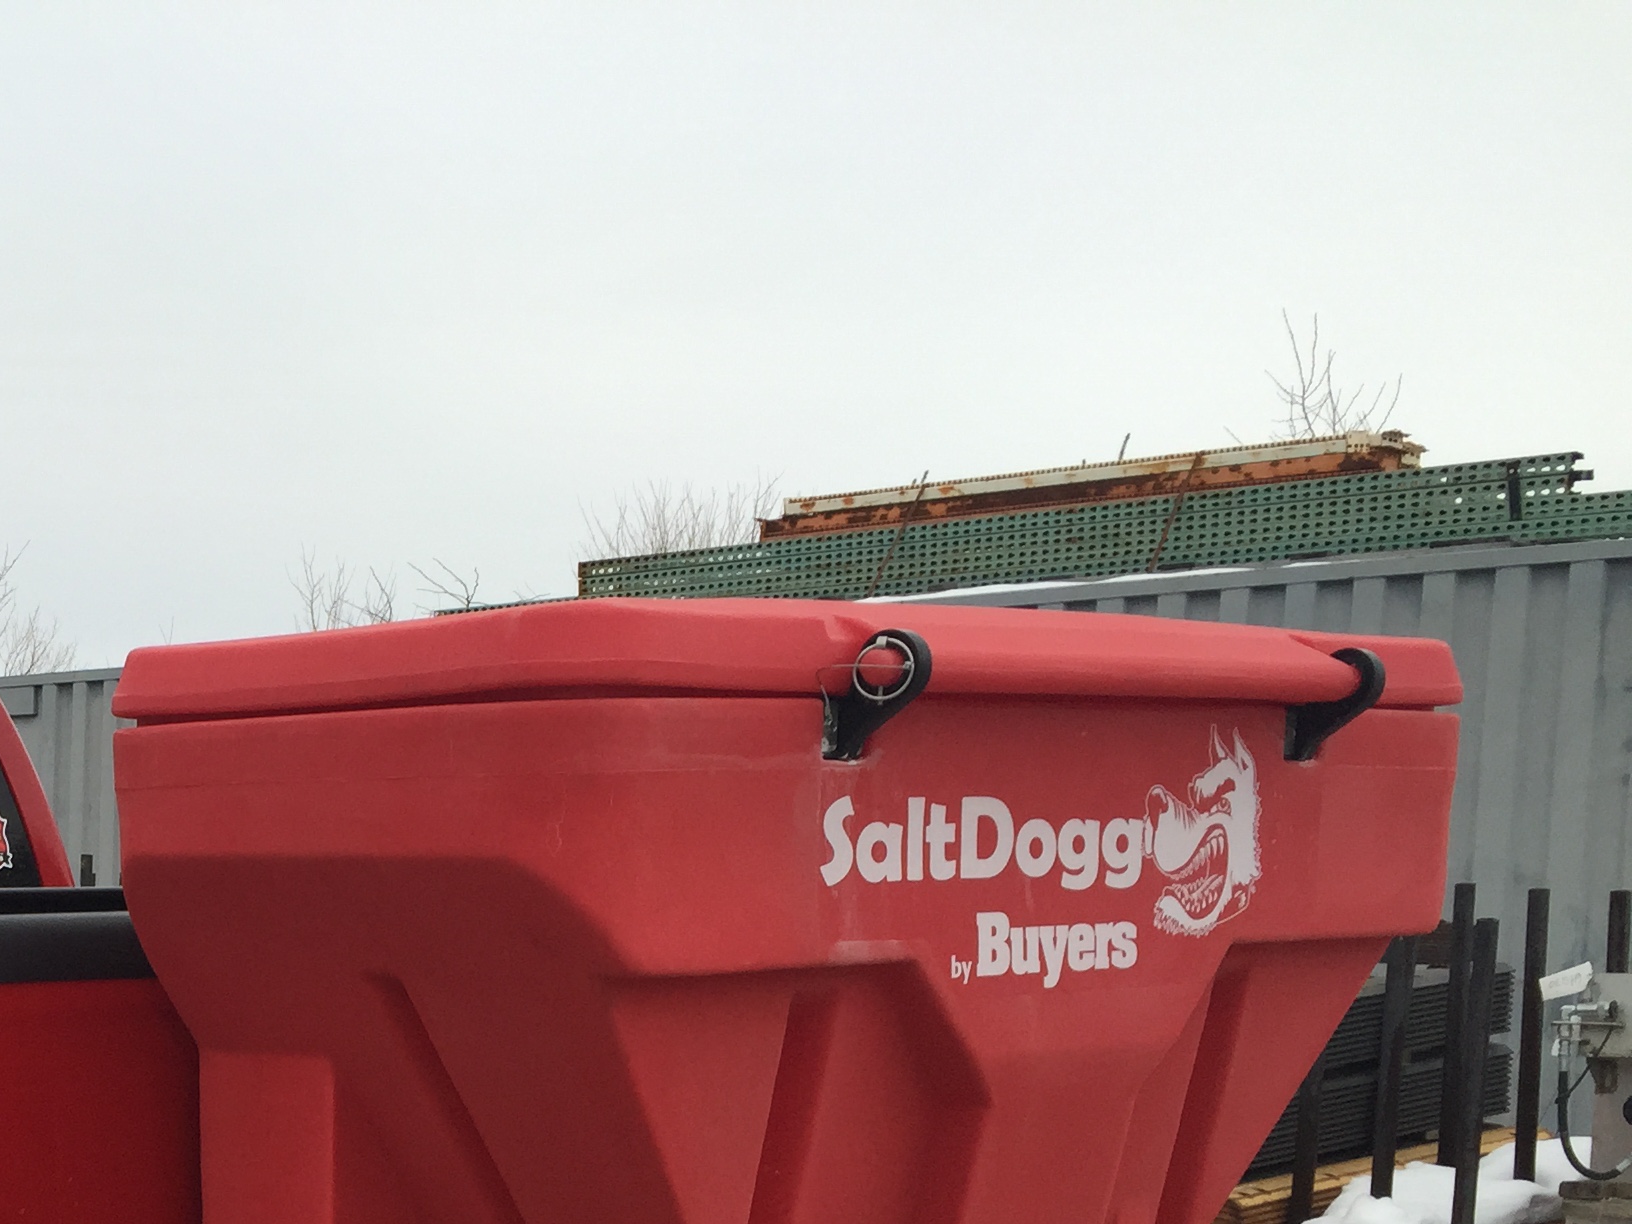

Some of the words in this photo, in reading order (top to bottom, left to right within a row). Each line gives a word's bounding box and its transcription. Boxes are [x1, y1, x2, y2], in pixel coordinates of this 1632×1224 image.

[820, 795, 1145, 890] SaltDogg
[951, 955, 972, 985] by
[976, 911, 1138, 989] Buyers
